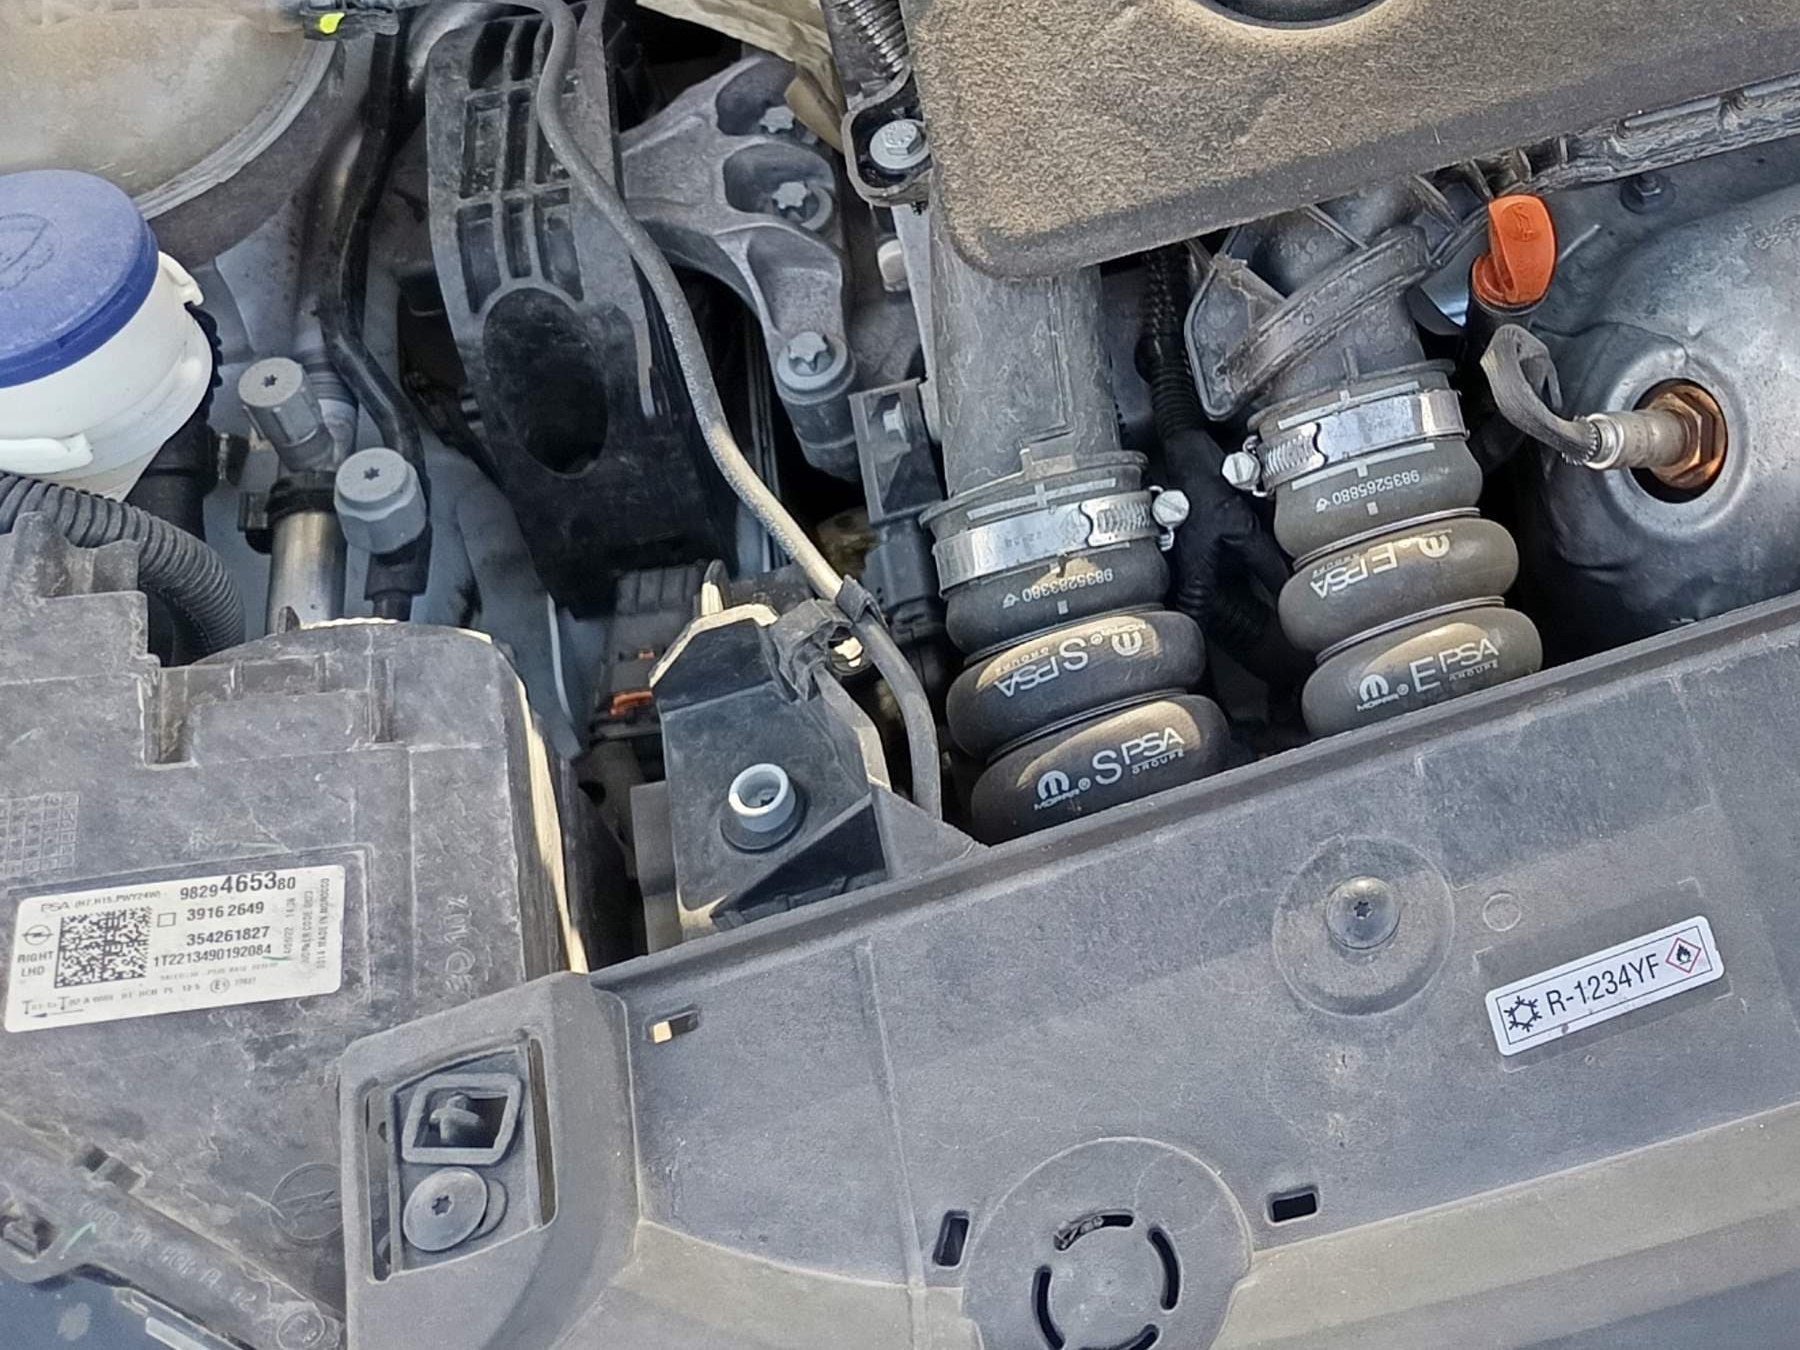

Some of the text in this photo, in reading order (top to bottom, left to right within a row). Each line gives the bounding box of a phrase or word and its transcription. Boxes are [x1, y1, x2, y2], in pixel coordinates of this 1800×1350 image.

[1309, 560, 1369, 599] PSA
[1438, 637, 1500, 672] PSA
[993, 654, 1060, 698] PSA
[1120, 726, 1185, 765] PSA
[180, 871, 296, 900] 9829465380
[186, 926, 271, 946] 354261827
[17, 950, 54, 963] RIGHT
[21, 966, 46, 977] LHD
[1545, 953, 1660, 1016] R-1234YF
